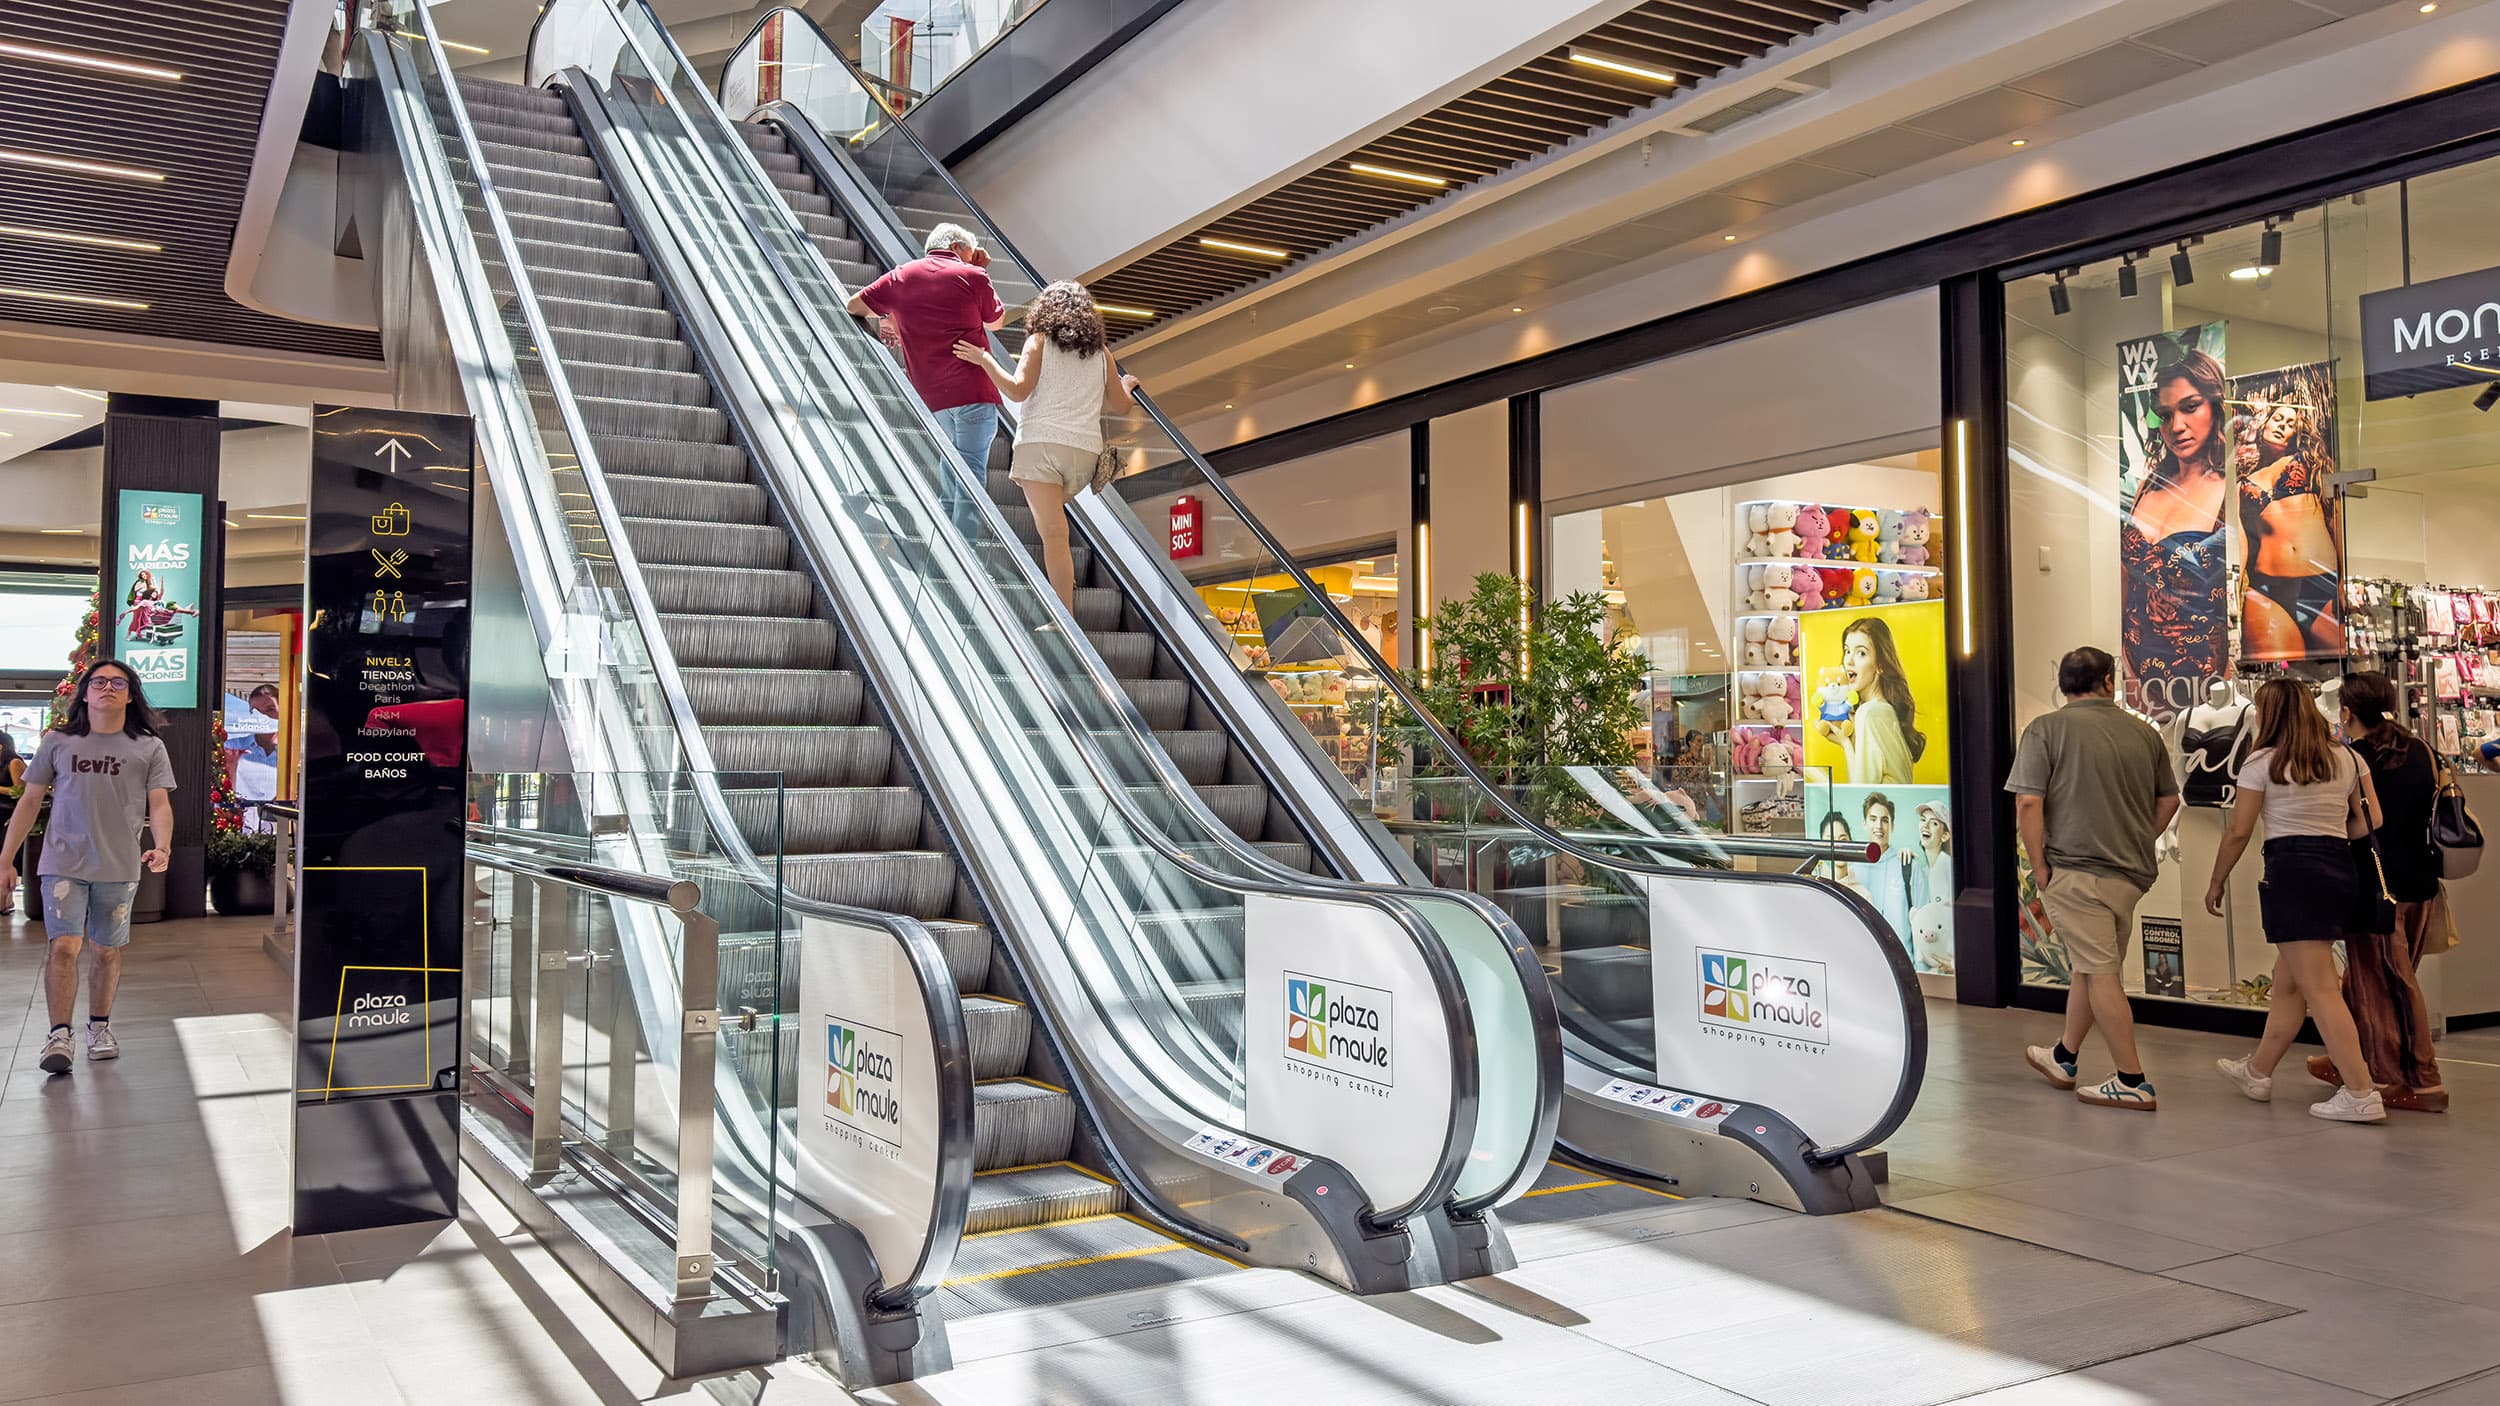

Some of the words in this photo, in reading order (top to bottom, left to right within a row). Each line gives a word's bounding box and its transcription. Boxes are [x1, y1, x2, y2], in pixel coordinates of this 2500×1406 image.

[2122, 340, 2158, 365] WA
[1172, 513, 1192, 532] MINI
[129, 539, 190, 562] MÁS
[129, 561, 188, 570] VARIEDAD
[129, 651, 185, 671] MÁS
[366, 657, 400, 667] NIVEL
[403, 657, 412, 667] 2
[138, 670, 184, 680] PCIONES
[359, 681, 415, 692] Decathlon
[374, 694, 401, 704] Paris
[374, 711, 400, 721] H&M
[357, 727, 417, 738] Happyland
[346, 752, 382, 763] FOOD
[384, 752, 425, 763] COURT
[364, 767, 407, 779] BAÑOS
[2144, 929, 2180, 939] CONTROL
[353, 993, 406, 1014] plaza
[1329, 995, 1379, 1031] plaza
[349, 1009, 410, 1028] maule
[1752, 1001, 1823, 1028] maule
[1703, 1026, 1765, 1046] shopping
[1777, 1039, 1826, 1056] center
[1329, 1034, 1388, 1068] maule
[856, 1041, 892, 1082] plaza
[1286, 1062, 1339, 1087] shopping
[1349, 1079, 1390, 1099] center
[856, 1087, 898, 1125] maule
[825, 1121, 863, 1148] shopping
[869, 1141, 900, 1161] center
